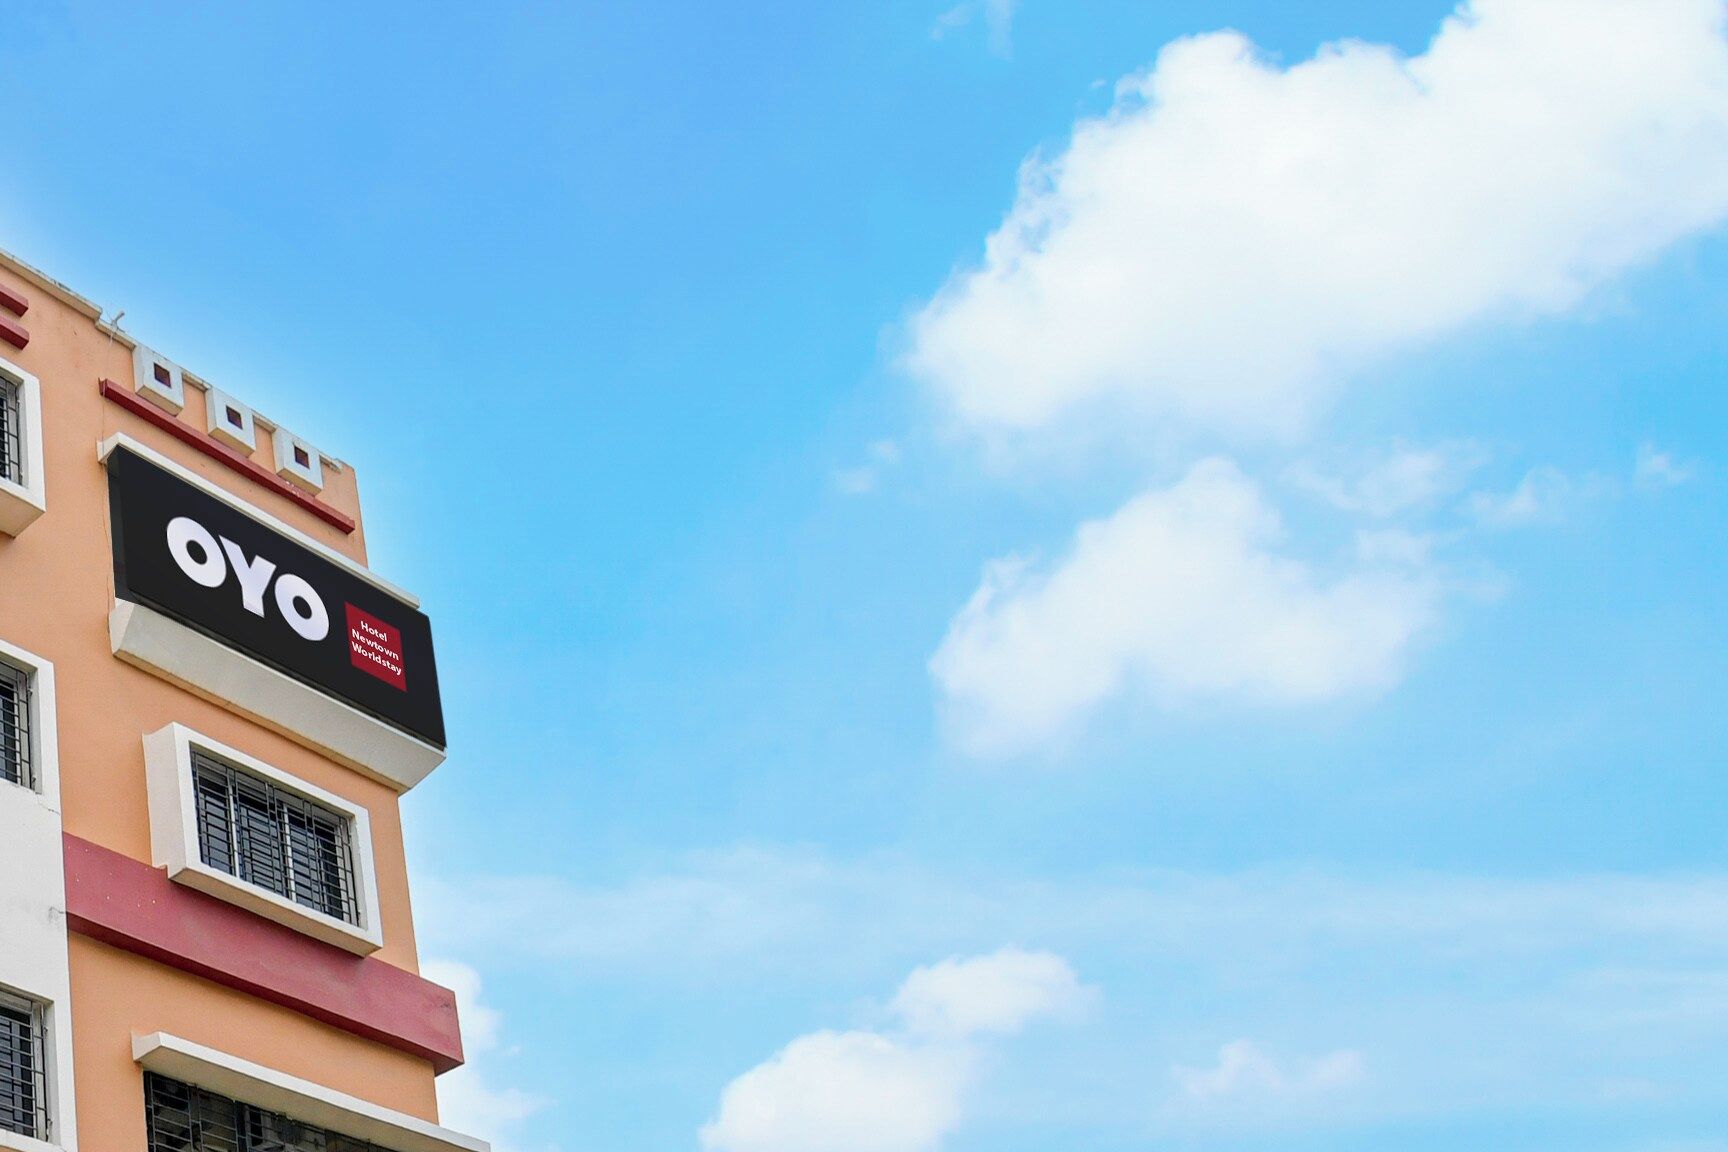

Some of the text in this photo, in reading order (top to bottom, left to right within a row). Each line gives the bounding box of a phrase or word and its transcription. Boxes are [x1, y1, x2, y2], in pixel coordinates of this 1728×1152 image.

[166, 516, 330, 642] OYO
[351, 628, 399, 661] Newtown
[360, 620, 388, 642] Hotel
[351, 640, 402, 676] Worldstay
